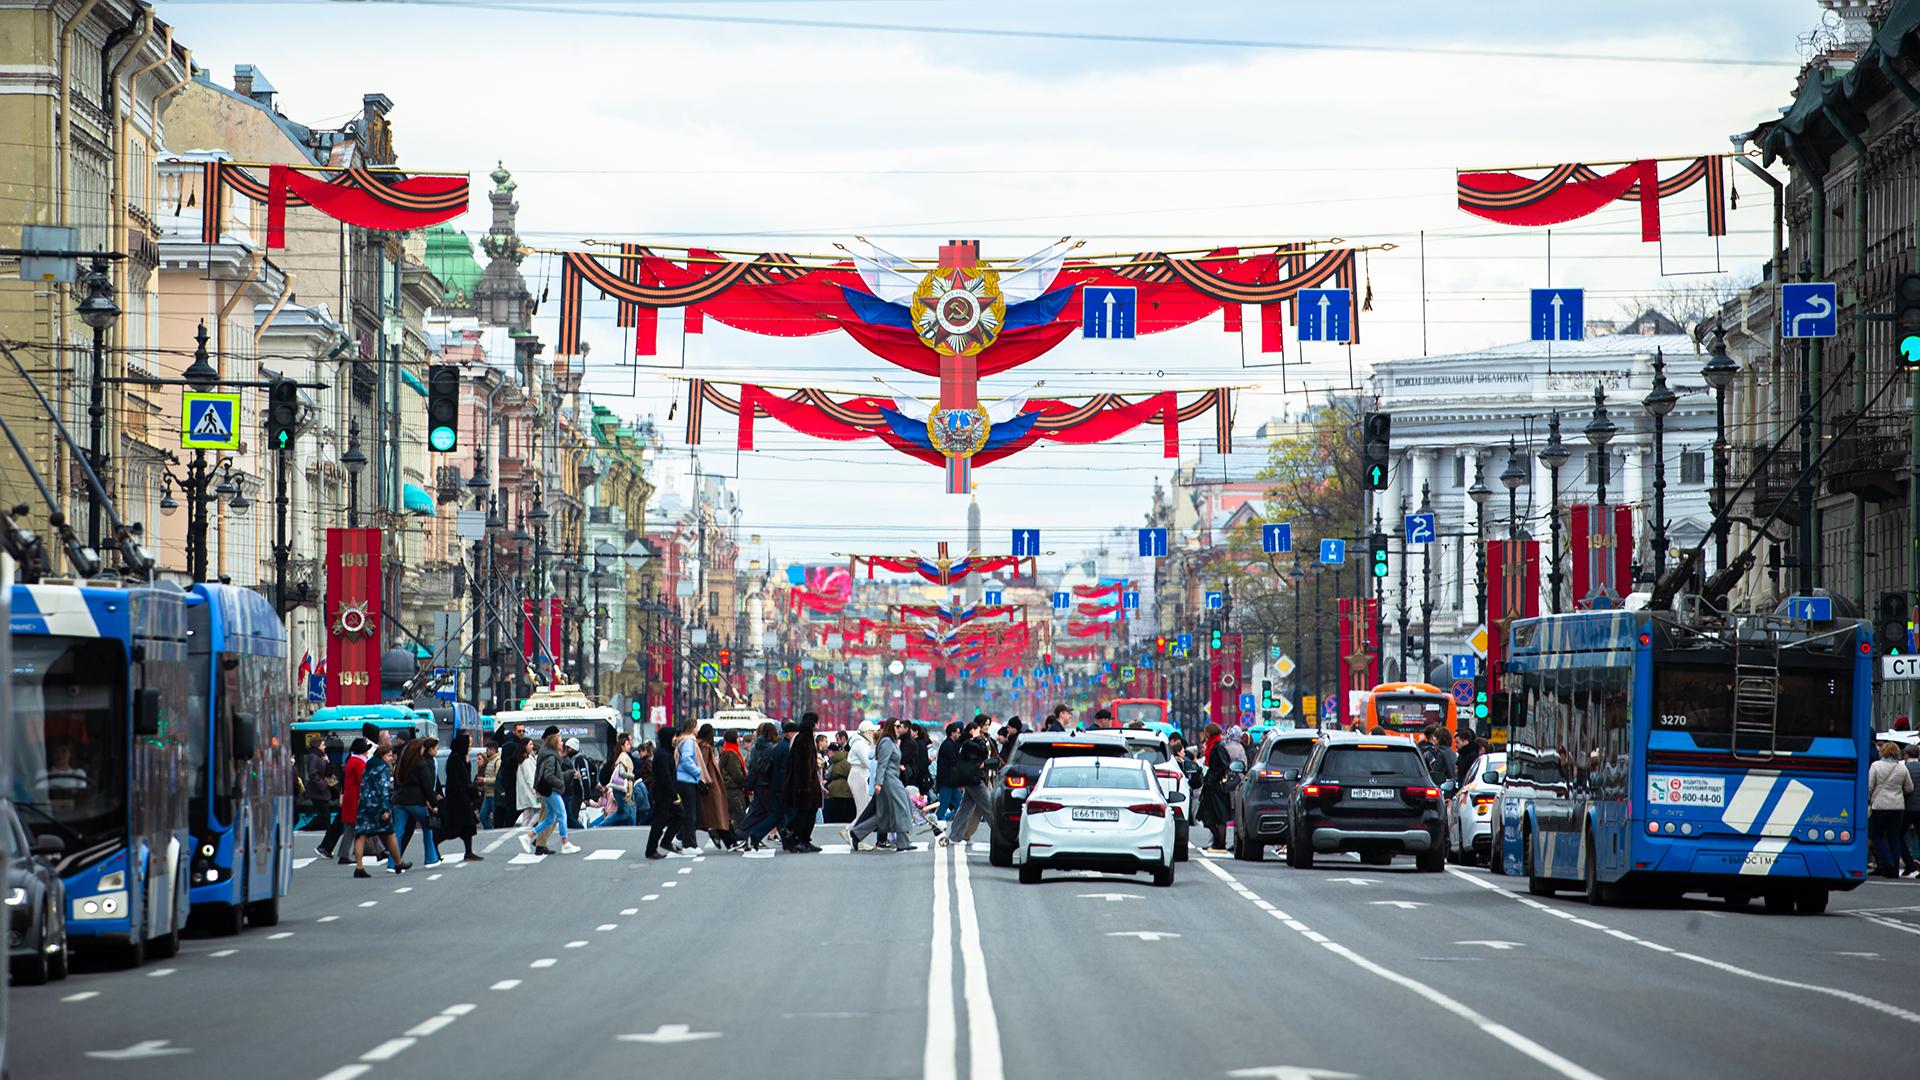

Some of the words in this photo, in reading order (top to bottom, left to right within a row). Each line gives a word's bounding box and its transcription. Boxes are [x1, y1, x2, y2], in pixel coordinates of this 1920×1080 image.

[1478, 372, 1529, 384] БИБЛИОТЕКА
[1586, 533, 1618, 548] 1941
[340, 552, 368, 567] 1941
[1893, 659, 1920, 675] СТ
[338, 671, 369, 685] 1945
[1661, 715, 1686, 725] 3270
[1682, 793, 1722, 803] 600-44-00
